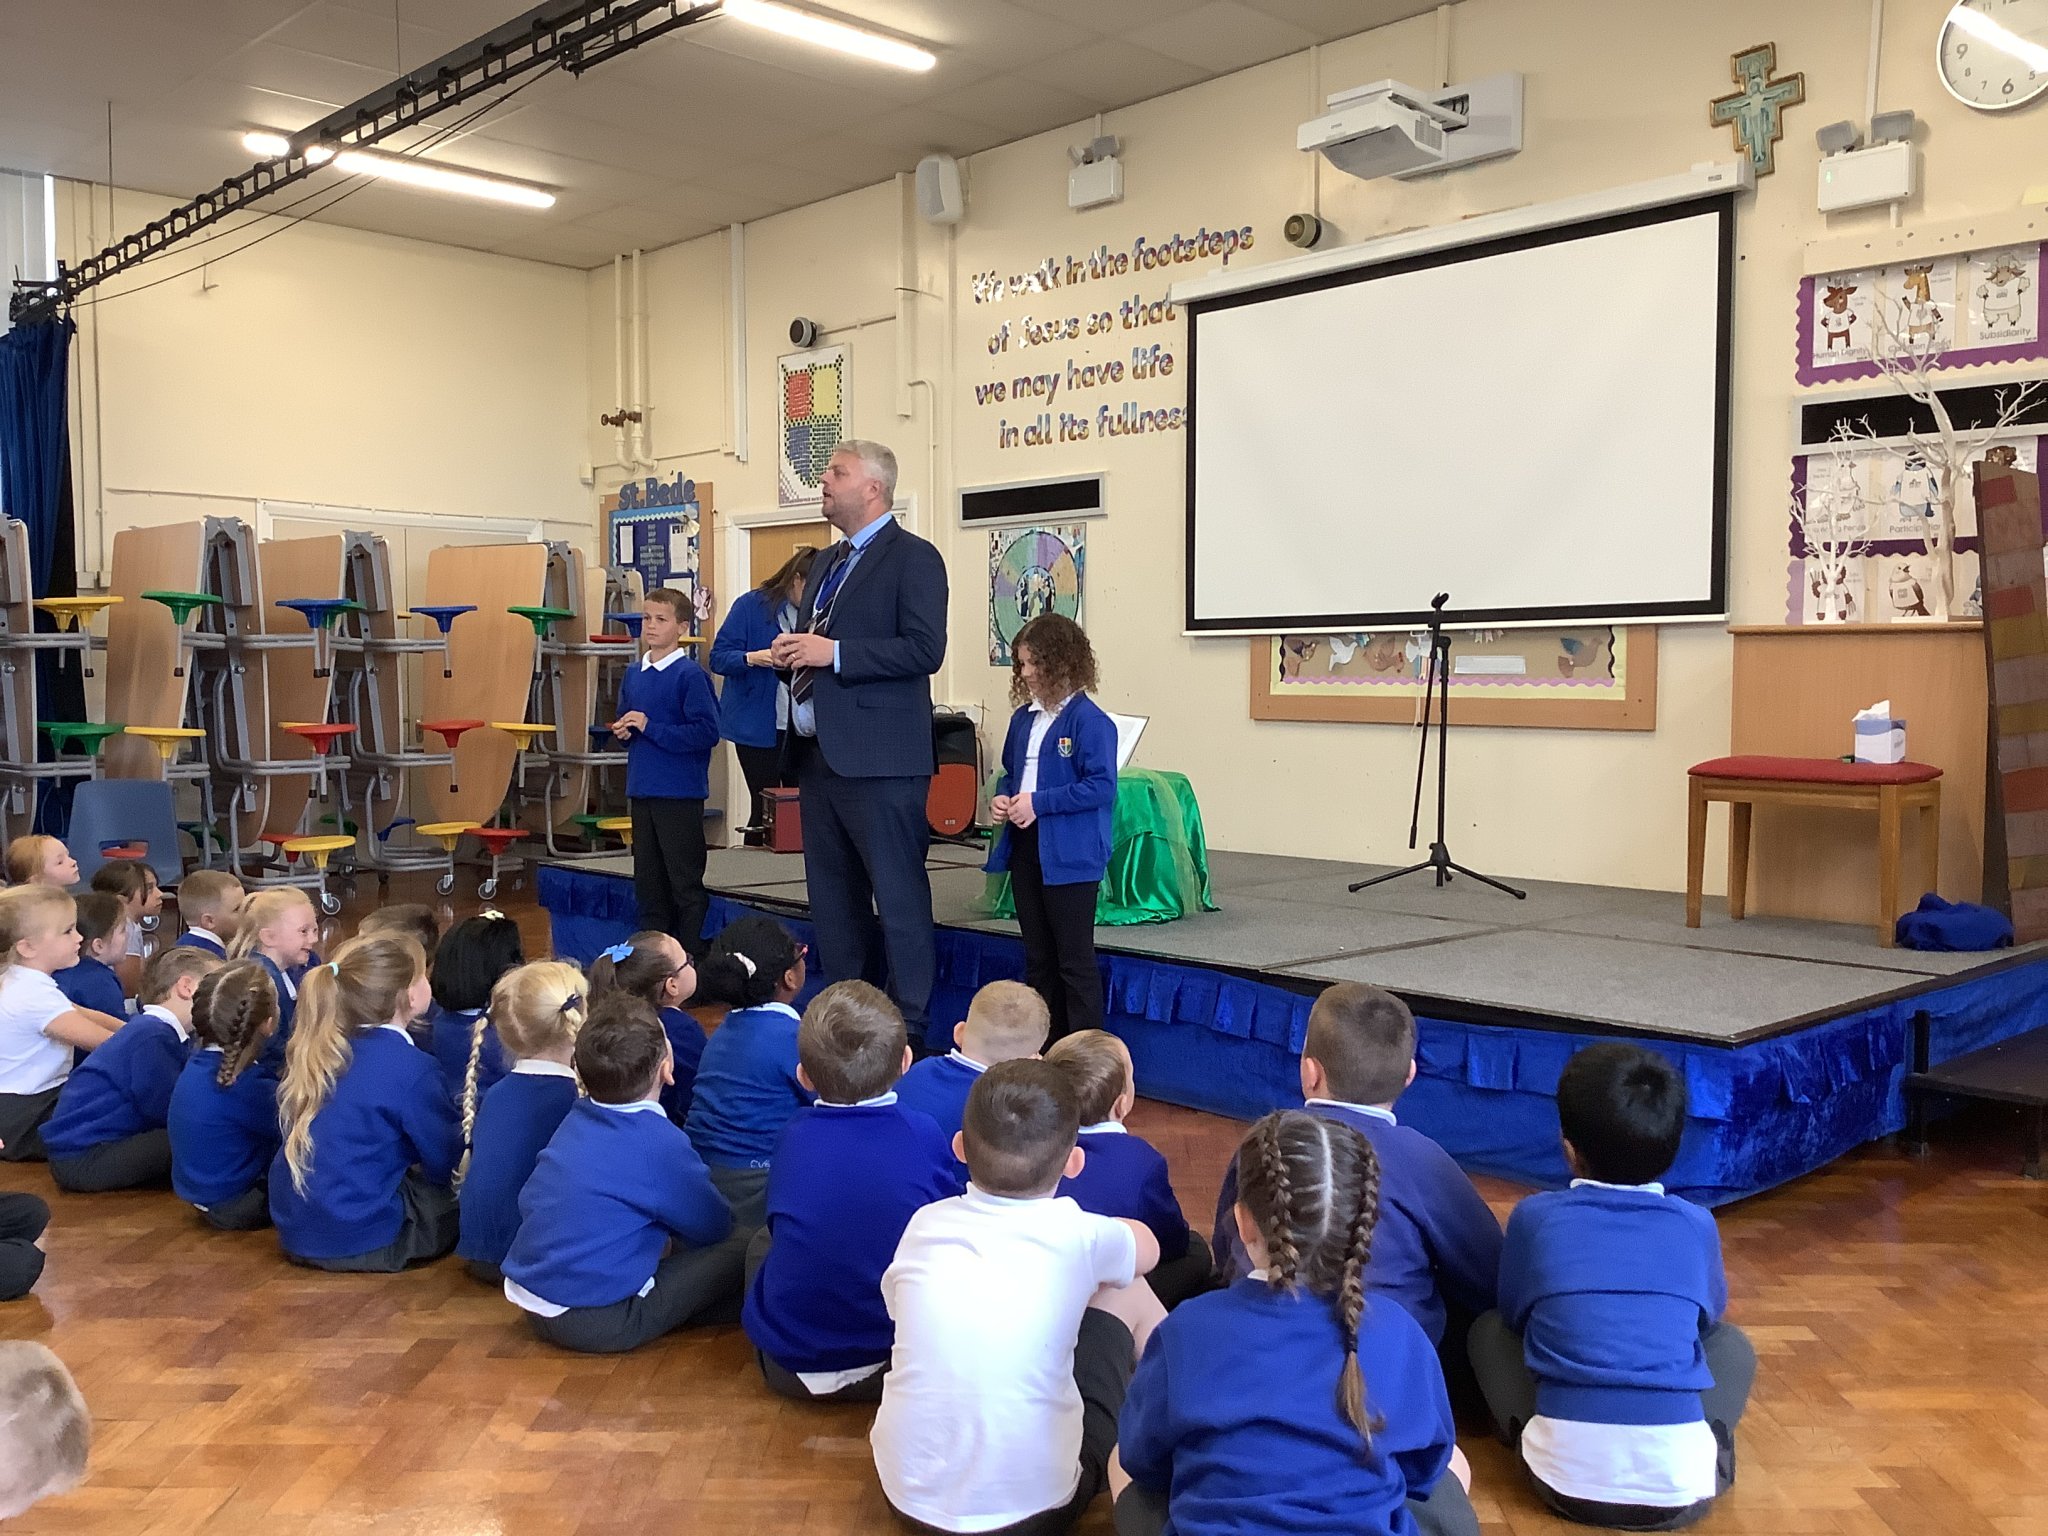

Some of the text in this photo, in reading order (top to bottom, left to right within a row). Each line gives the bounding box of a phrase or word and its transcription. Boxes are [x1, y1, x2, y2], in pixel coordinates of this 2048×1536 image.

[1956, 43, 1968, 60] 9
[1964, 67, 1971, 77] 8
[2028, 70, 2036, 80] 5
[1981, 80, 1988, 90] 7
[2001, 78, 2014, 95] 6
[1066, 255, 1086, 285] in
[1089, 245, 1129, 280] the
[1132, 226, 1255, 272] footsteps
[987, 293, 1176, 355] of Jesus so that
[1980, 328, 2031, 340] Subsidiarity
[975, 344, 1174, 406] we may have life
[1000, 419, 1019, 448] in
[1024, 413, 1053, 446] all
[1059, 412, 1090, 442] its
